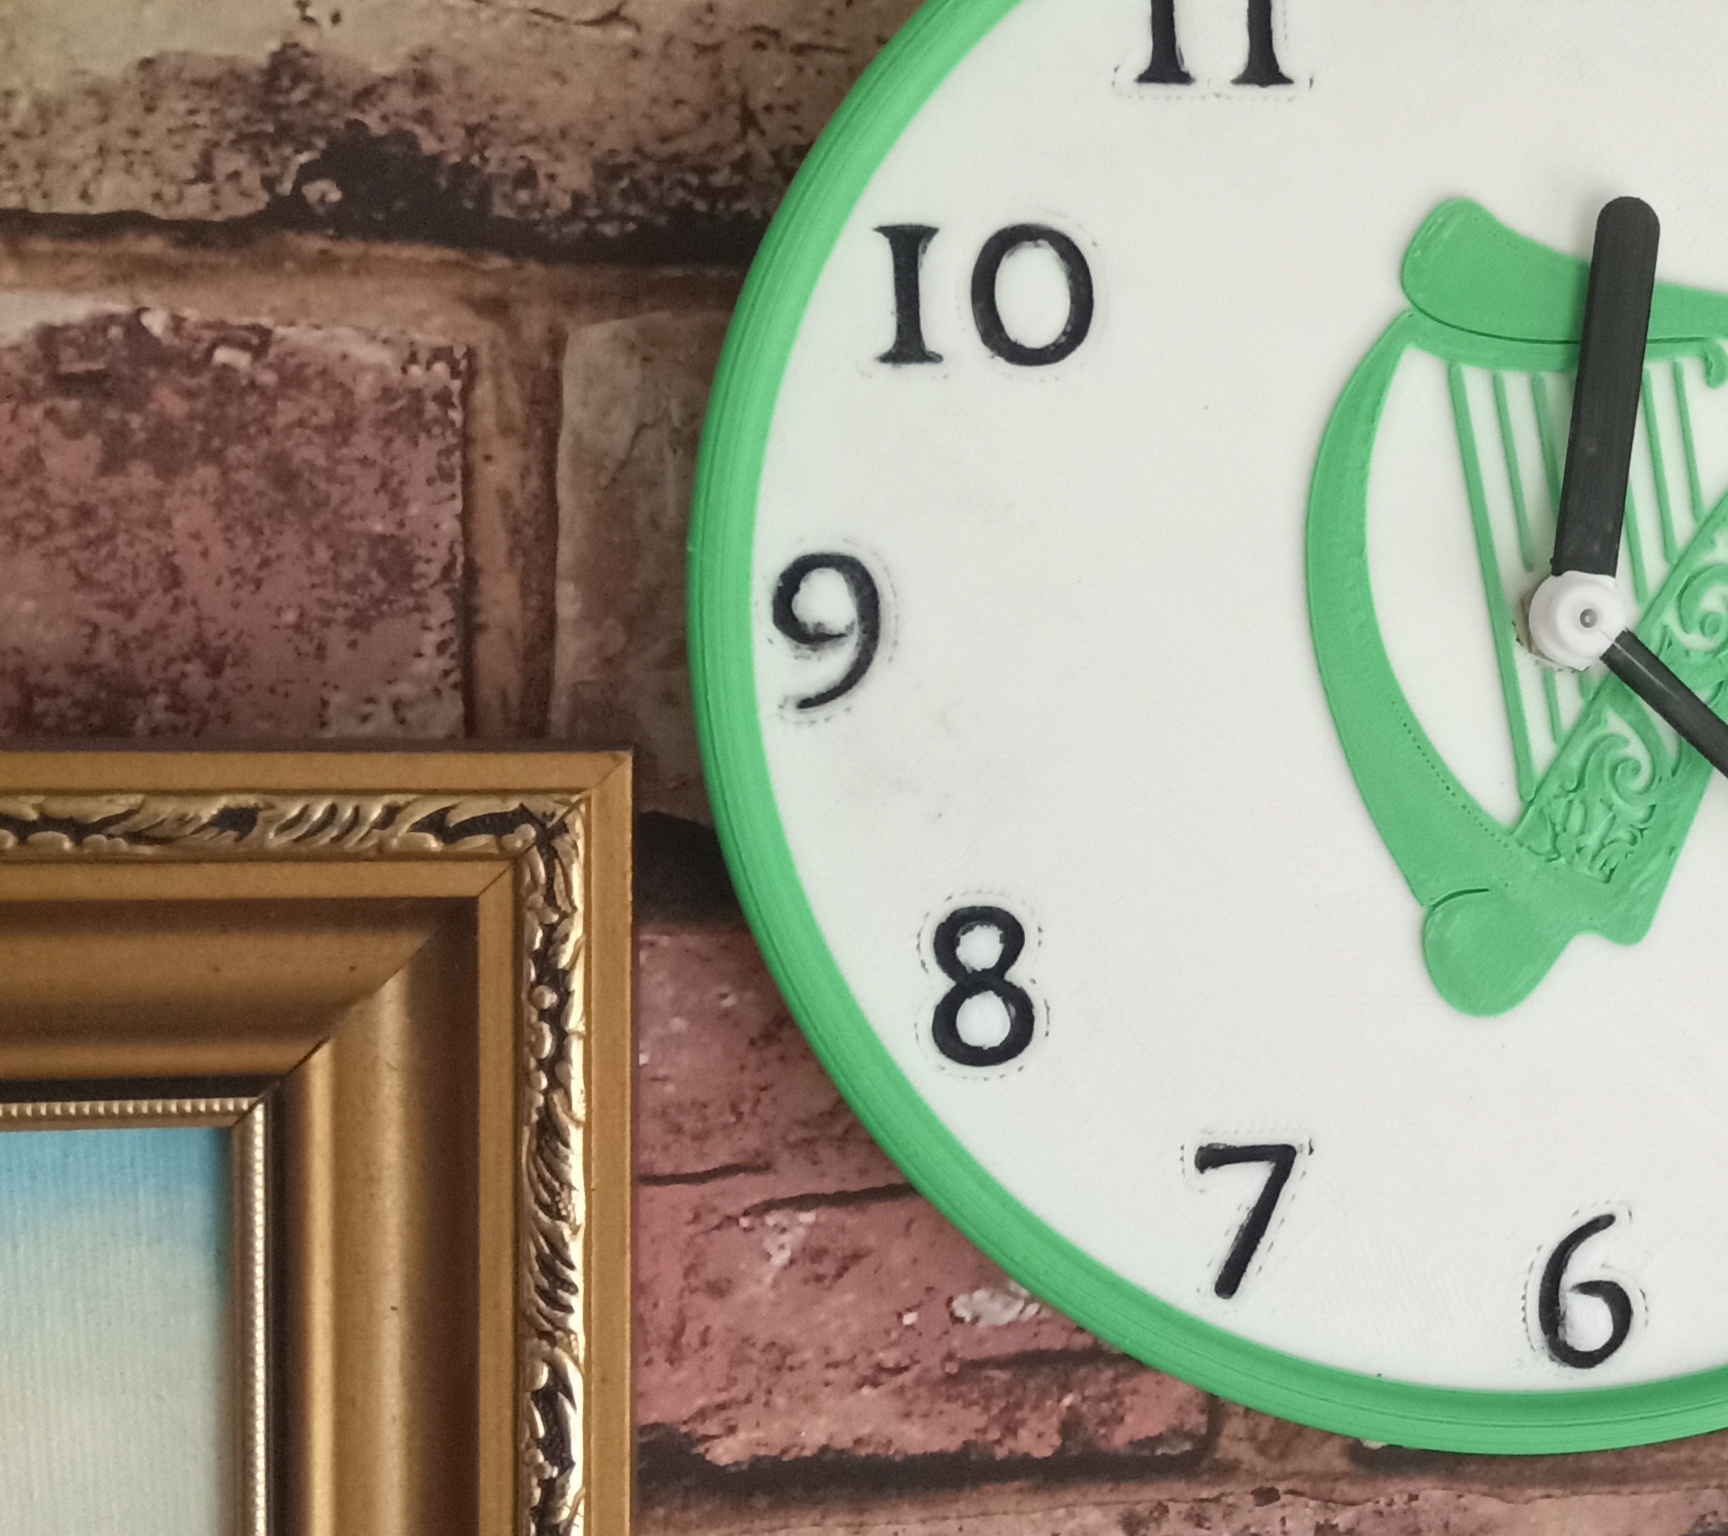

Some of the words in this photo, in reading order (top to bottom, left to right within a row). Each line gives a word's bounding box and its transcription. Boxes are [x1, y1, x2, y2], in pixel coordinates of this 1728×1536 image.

[873, 222, 1095, 368] 10
[770, 552, 882, 711] 9
[930, 904, 1037, 1069] 8
[1193, 1142, 1299, 1301] 7
[1537, 1213, 1635, 1371] 6
